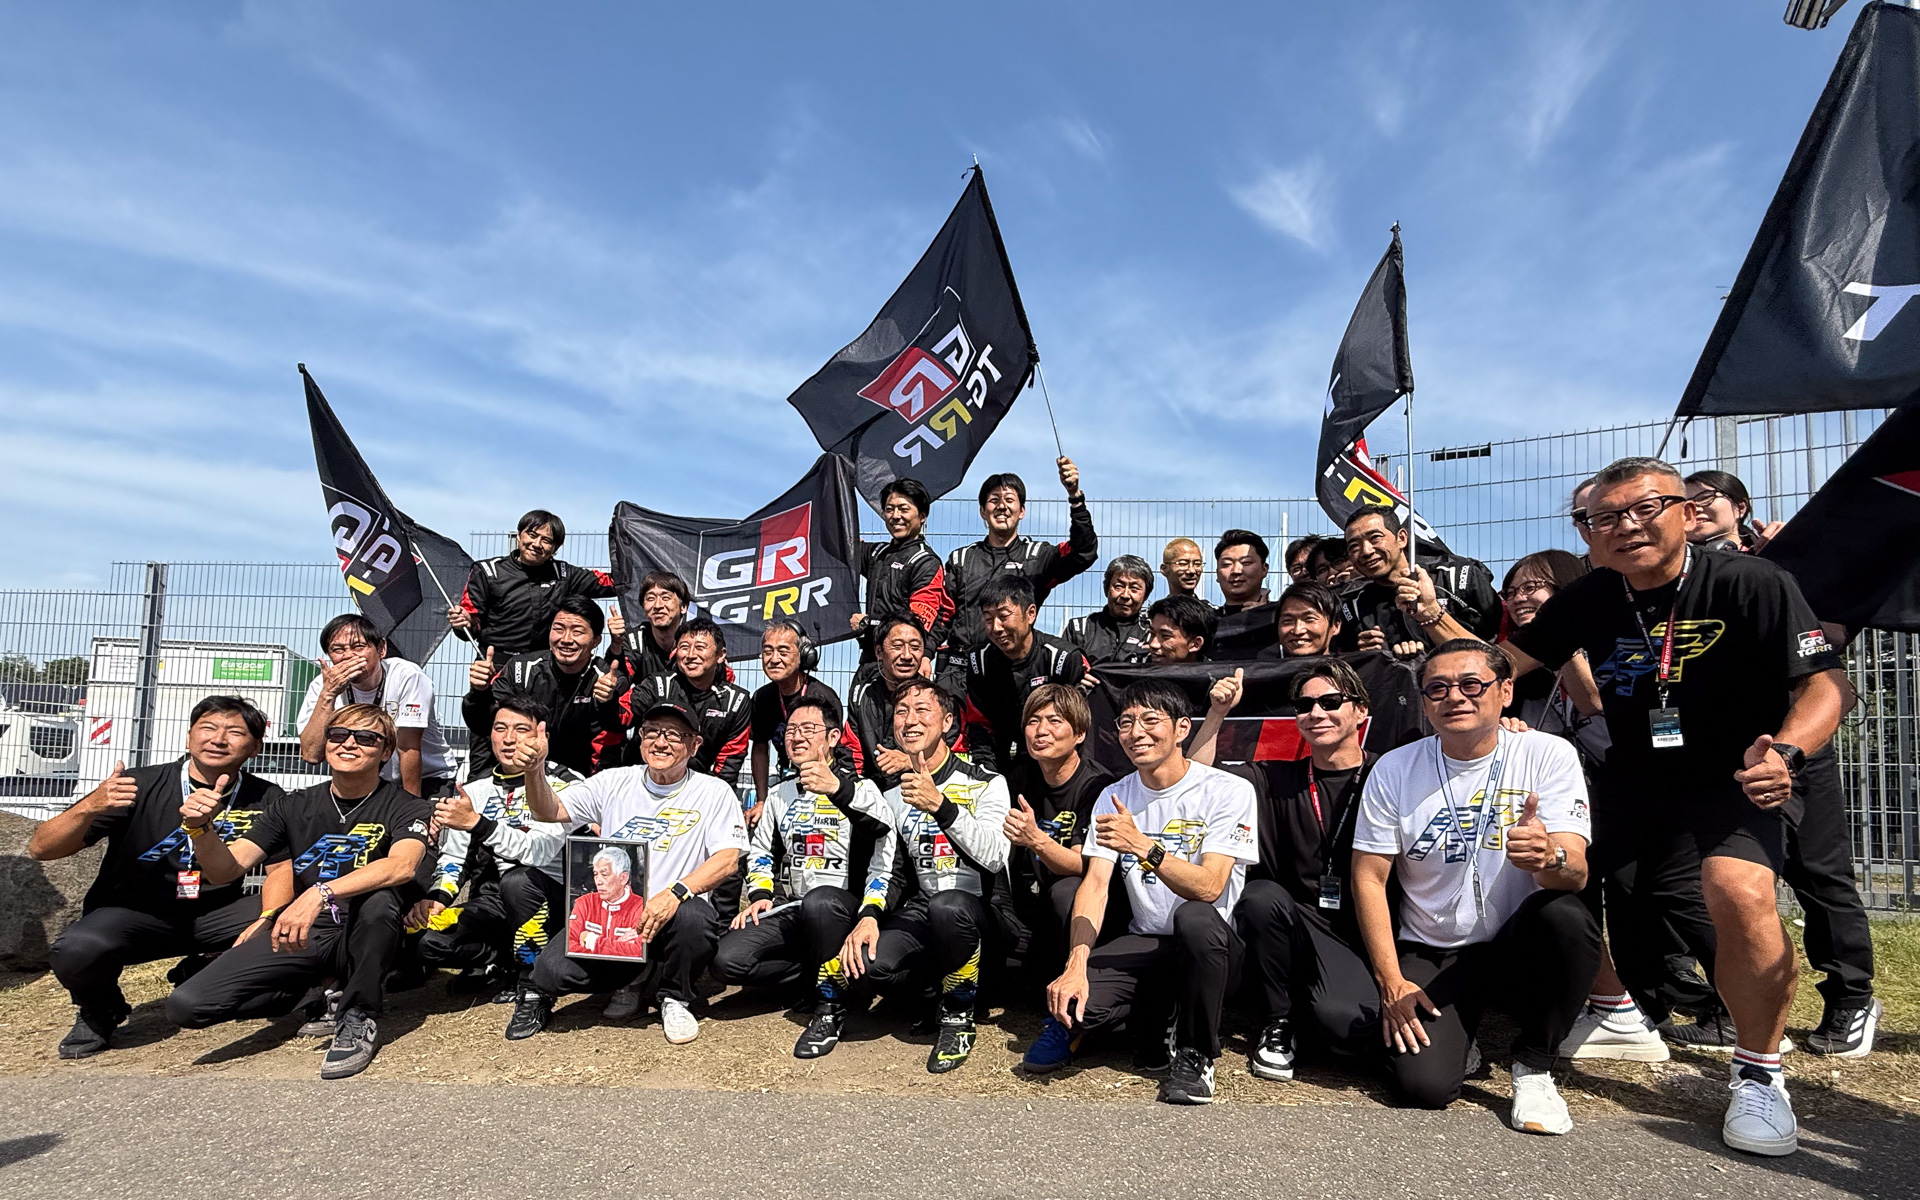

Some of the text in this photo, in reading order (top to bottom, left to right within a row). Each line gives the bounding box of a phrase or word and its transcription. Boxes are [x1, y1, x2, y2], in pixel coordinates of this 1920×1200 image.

[702, 536, 807, 590] GR
[1800, 636, 1825, 649] GR
[1797, 644, 1832, 657] TGRR
[793, 842, 823, 855] GR
[919, 843, 952, 855] GR
